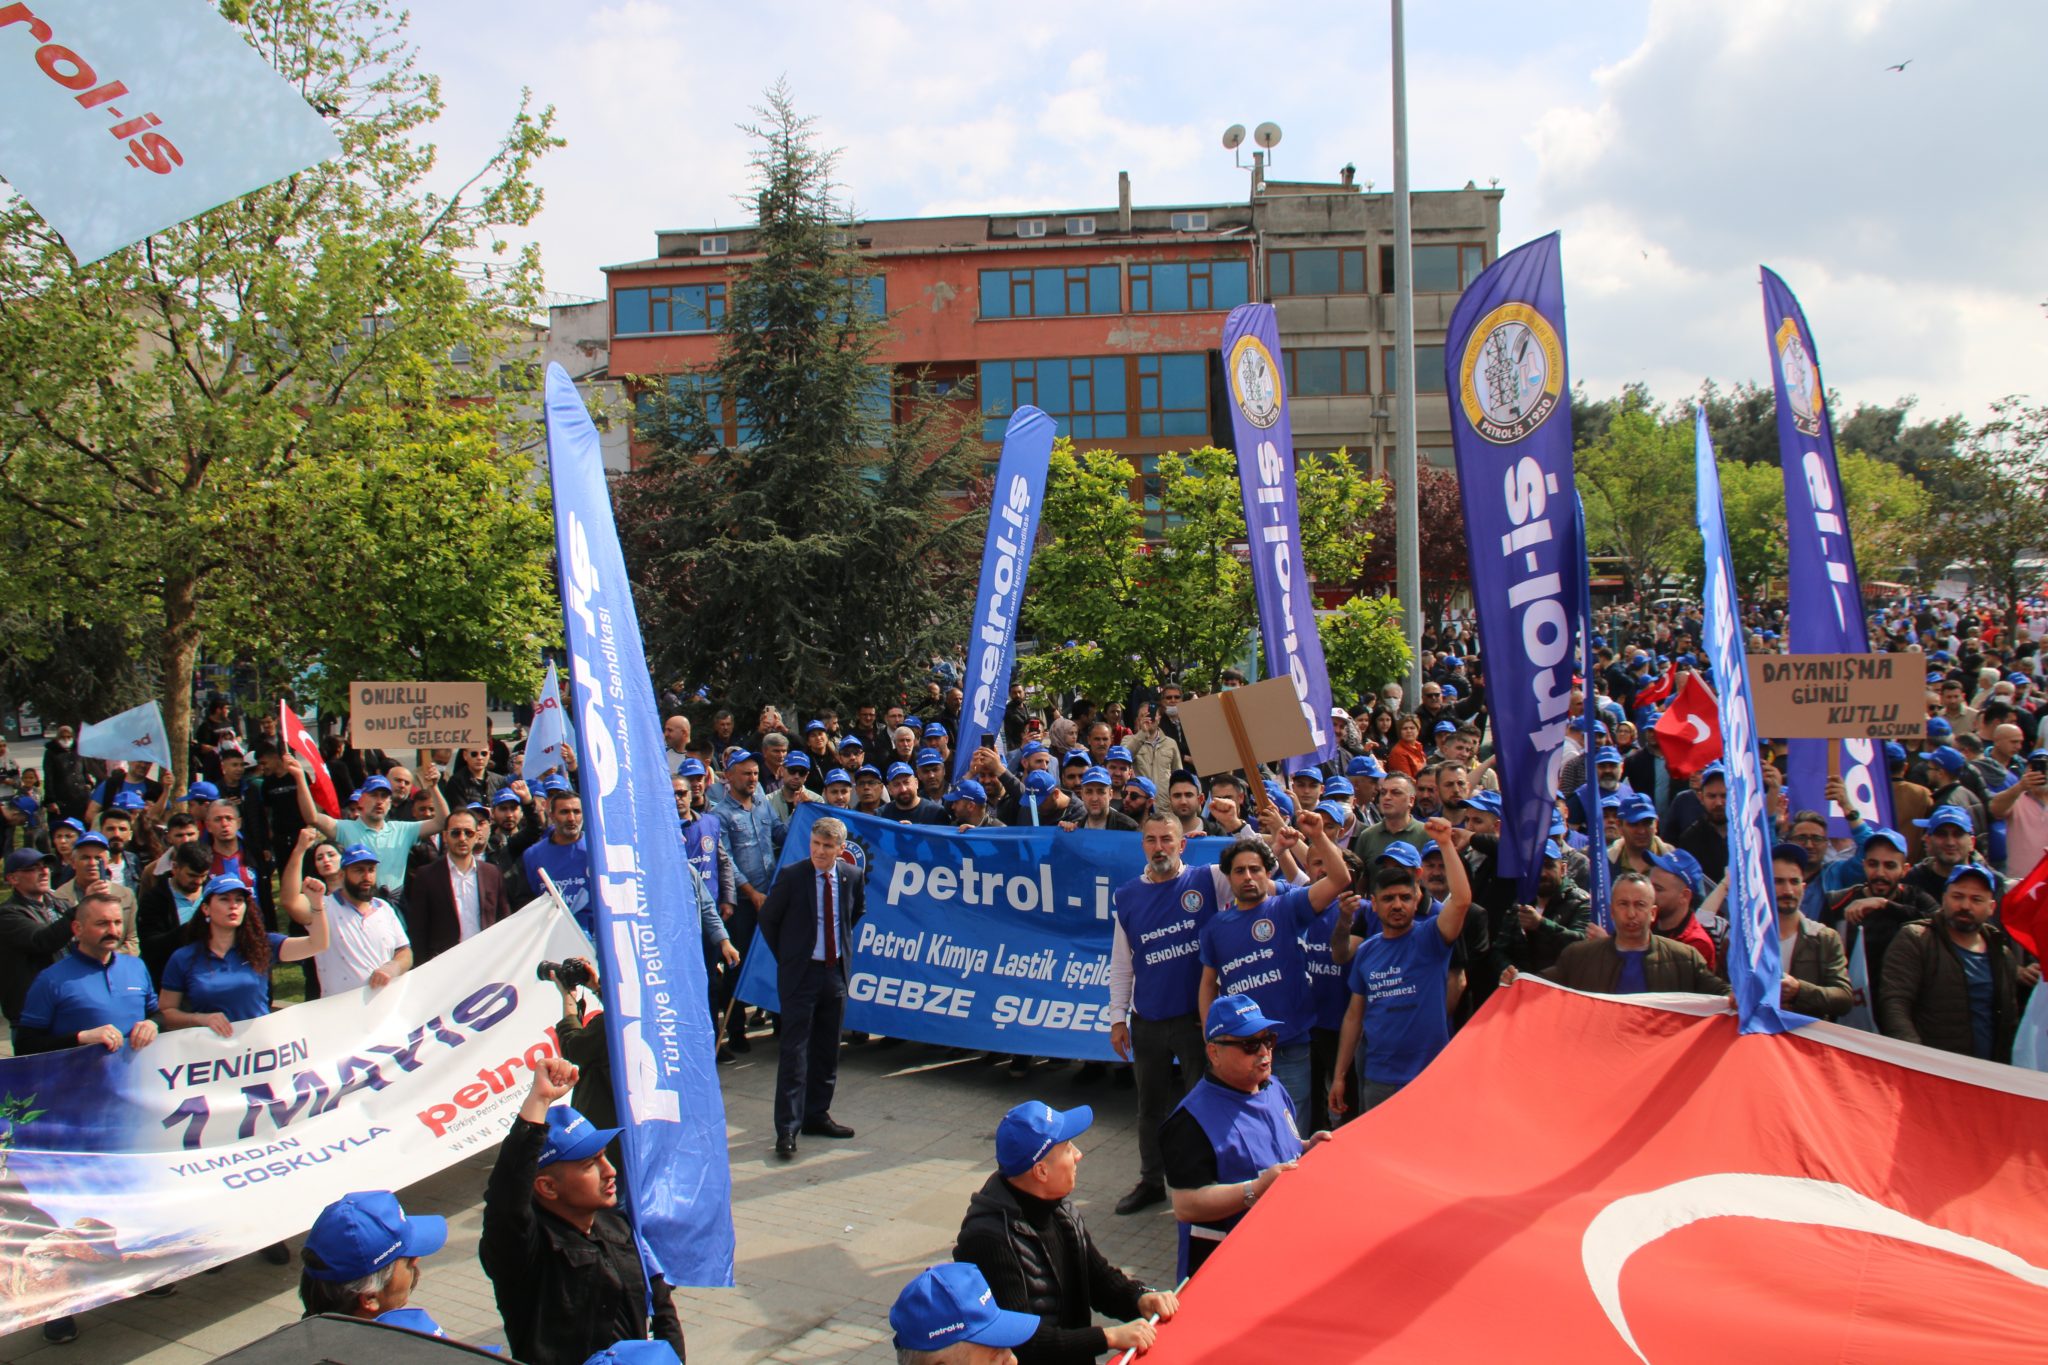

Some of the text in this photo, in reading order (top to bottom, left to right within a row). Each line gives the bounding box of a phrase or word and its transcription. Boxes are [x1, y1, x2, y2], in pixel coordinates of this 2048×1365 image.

[1481, 399, 1552, 440] PETROL-İŞ 1950
[973, 474, 1030, 729] petrol-iş
[1501, 456, 1571, 800] trol-iş
[599, 607, 624, 701] Sendikası
[1762, 658, 1893, 683] DAYANIŞMA
[361, 687, 427, 705] ONURLU
[1792, 682, 1848, 704] GÜNÜ
[365, 716, 428, 731] ONURLU
[1828, 704, 1899, 724] KUTLU
[1866, 722, 1921, 737] OLSUN
[568, 511, 681, 1125] petroliş
[887, 857, 1054, 913] petrol
[1095, 876, 1119, 920] i
[1140, 919, 1196, 944] petrol-iş
[638, 923, 667, 986] Petrol
[858, 923, 1111, 990] Petrol Kimya Lastik işçile
[1221, 947, 1274, 976] petrol-iş
[1307, 960, 1341, 977] İKASI
[848, 972, 1113, 1033] GEBZE ŞUBES
[1227, 968, 1282, 997] SENDİKASI
[654, 992, 681, 1077] Türkiye
[158, 1038, 309, 1091] YENİDEN
[161, 982, 519, 1150] 1 MAYIS
[416, 1025, 562, 1138] petrol
[476, 1102, 499, 1119] Petrol
[498, 1089, 522, 1108] Kimya
[169, 1137, 301, 1178] YILMADAN
[222, 1126, 391, 1190] COŞKUYLA
[928, 1321, 965, 1339] petrol-iş
